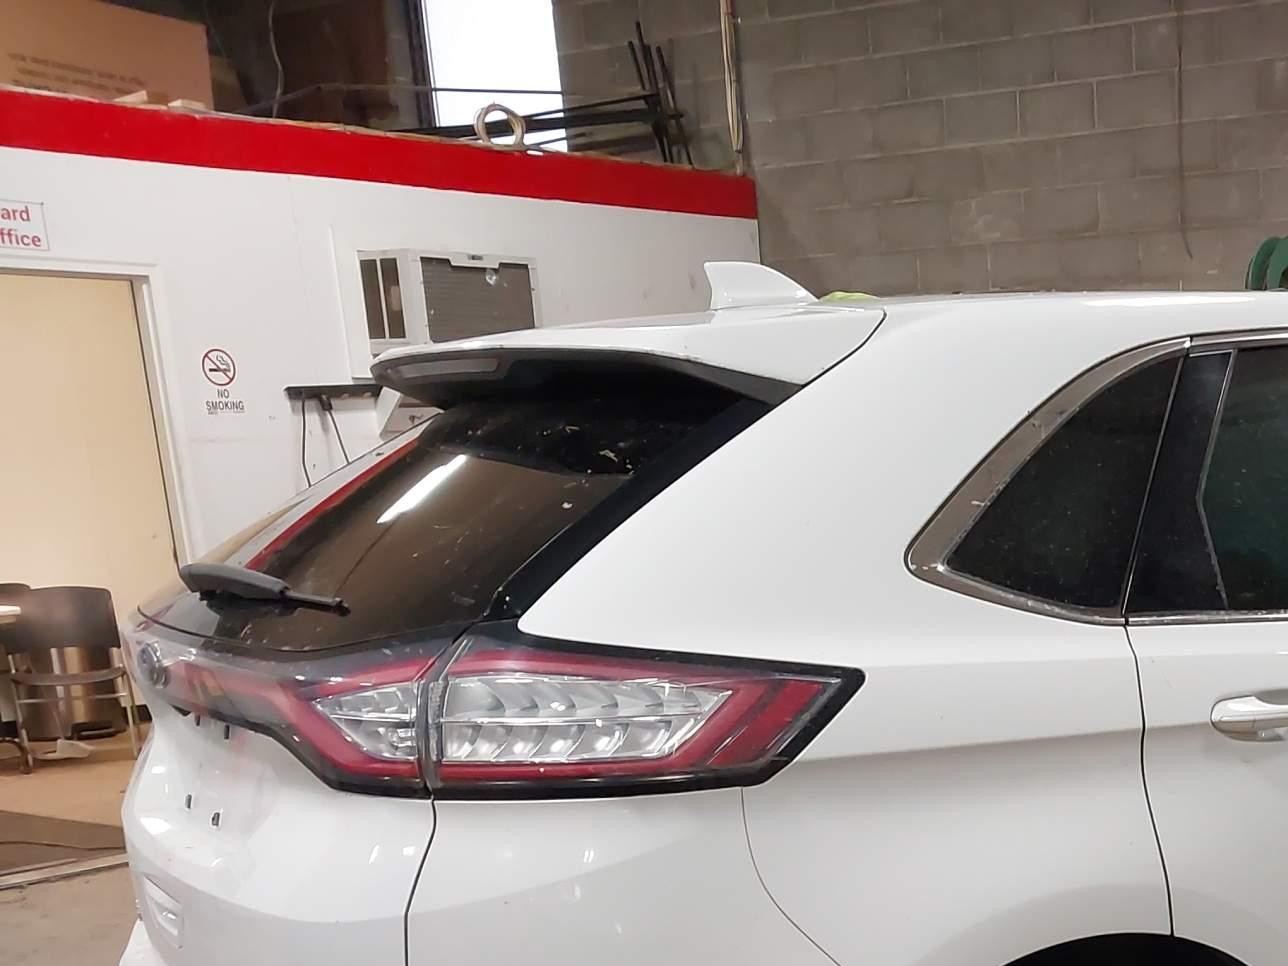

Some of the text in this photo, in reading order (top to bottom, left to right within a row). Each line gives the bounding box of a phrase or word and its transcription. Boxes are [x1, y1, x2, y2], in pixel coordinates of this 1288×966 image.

[0, 205, 31, 222] ard
[217, 388, 230, 399] NO
[205, 400, 245, 412] SMOKING
